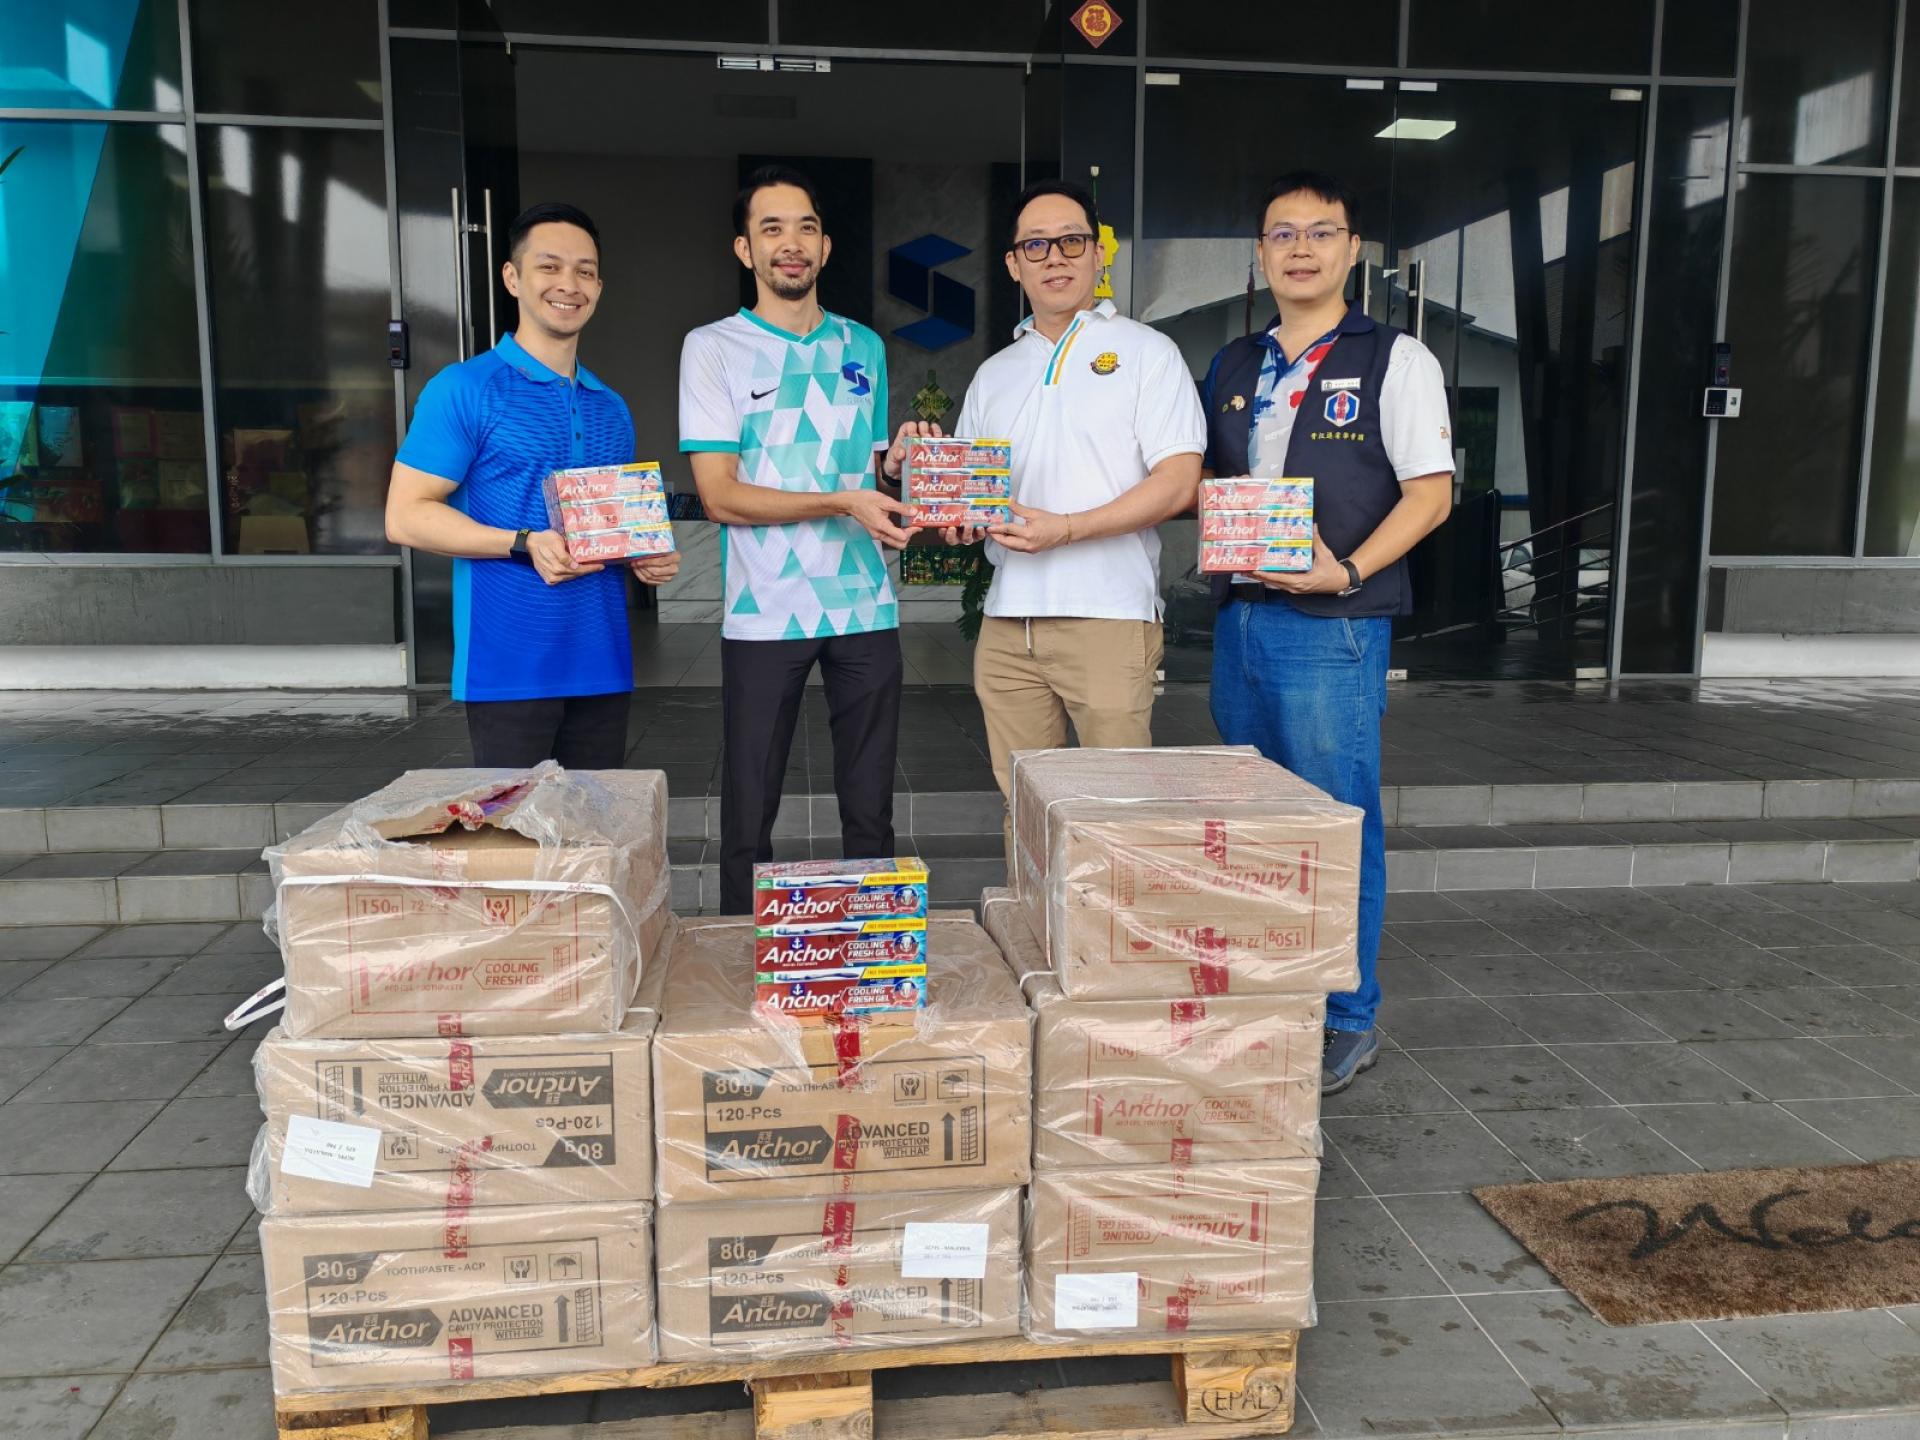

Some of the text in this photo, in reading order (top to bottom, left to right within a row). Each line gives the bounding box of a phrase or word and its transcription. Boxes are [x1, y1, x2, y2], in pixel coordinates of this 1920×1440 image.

[914, 451, 960, 462] Anchor
[914, 481, 959, 492] Anchor
[914, 511, 959, 522] Anchor
[848, 894, 886, 903] COOLING
[876, 902, 890, 910] GEL
[761, 896, 841, 917] Anchor
[847, 942, 885, 950] COOLING
[1268, 931, 1302, 947] 150g
[761, 944, 841, 965] Anchor
[847, 949, 890, 958] FRESH GEL
[485, 963, 539, 974] COOLING
[485, 976, 523, 986] FRESH
[848, 987, 885, 996] COOLING
[767, 990, 841, 1009] Anchor
[399, 1073, 429, 1083] WITH
[378, 1084, 440, 1094] PROTECTION
[494, 1075, 602, 1098] Anchor
[715, 1077, 753, 1097] 80g
[379, 1093, 476, 1109] ADVANCED
[1108, 1097, 1194, 1118] Anchor
[716, 1106, 782, 1122] 120-Pcs
[535, 1115, 602, 1131] 120-Pcs
[844, 1121, 930, 1140] ADVANCED
[564, 1140, 604, 1160] 80g
[719, 1135, 822, 1160] Anchor
[871, 1137, 930, 1148] PROTECTION
[883, 1146, 930, 1158] WITH HAP
[1102, 1231, 1151, 1241] COOLING
[316, 1260, 357, 1280] 80g
[386, 1264, 456, 1277] TOOTHPASTE
[463, 1262, 486, 1272] ACP
[722, 1272, 785, 1287] 120-Pcs
[319, 1289, 388, 1305] 120-Pcs
[448, 1303, 544, 1322] ADVANCED
[721, 1300, 823, 1324] Anchor
[323, 1319, 432, 1344] Anchor
[448, 1319, 544, 1333] CAVITY PROTECTION
[495, 1329, 544, 1340] WITH HAP
